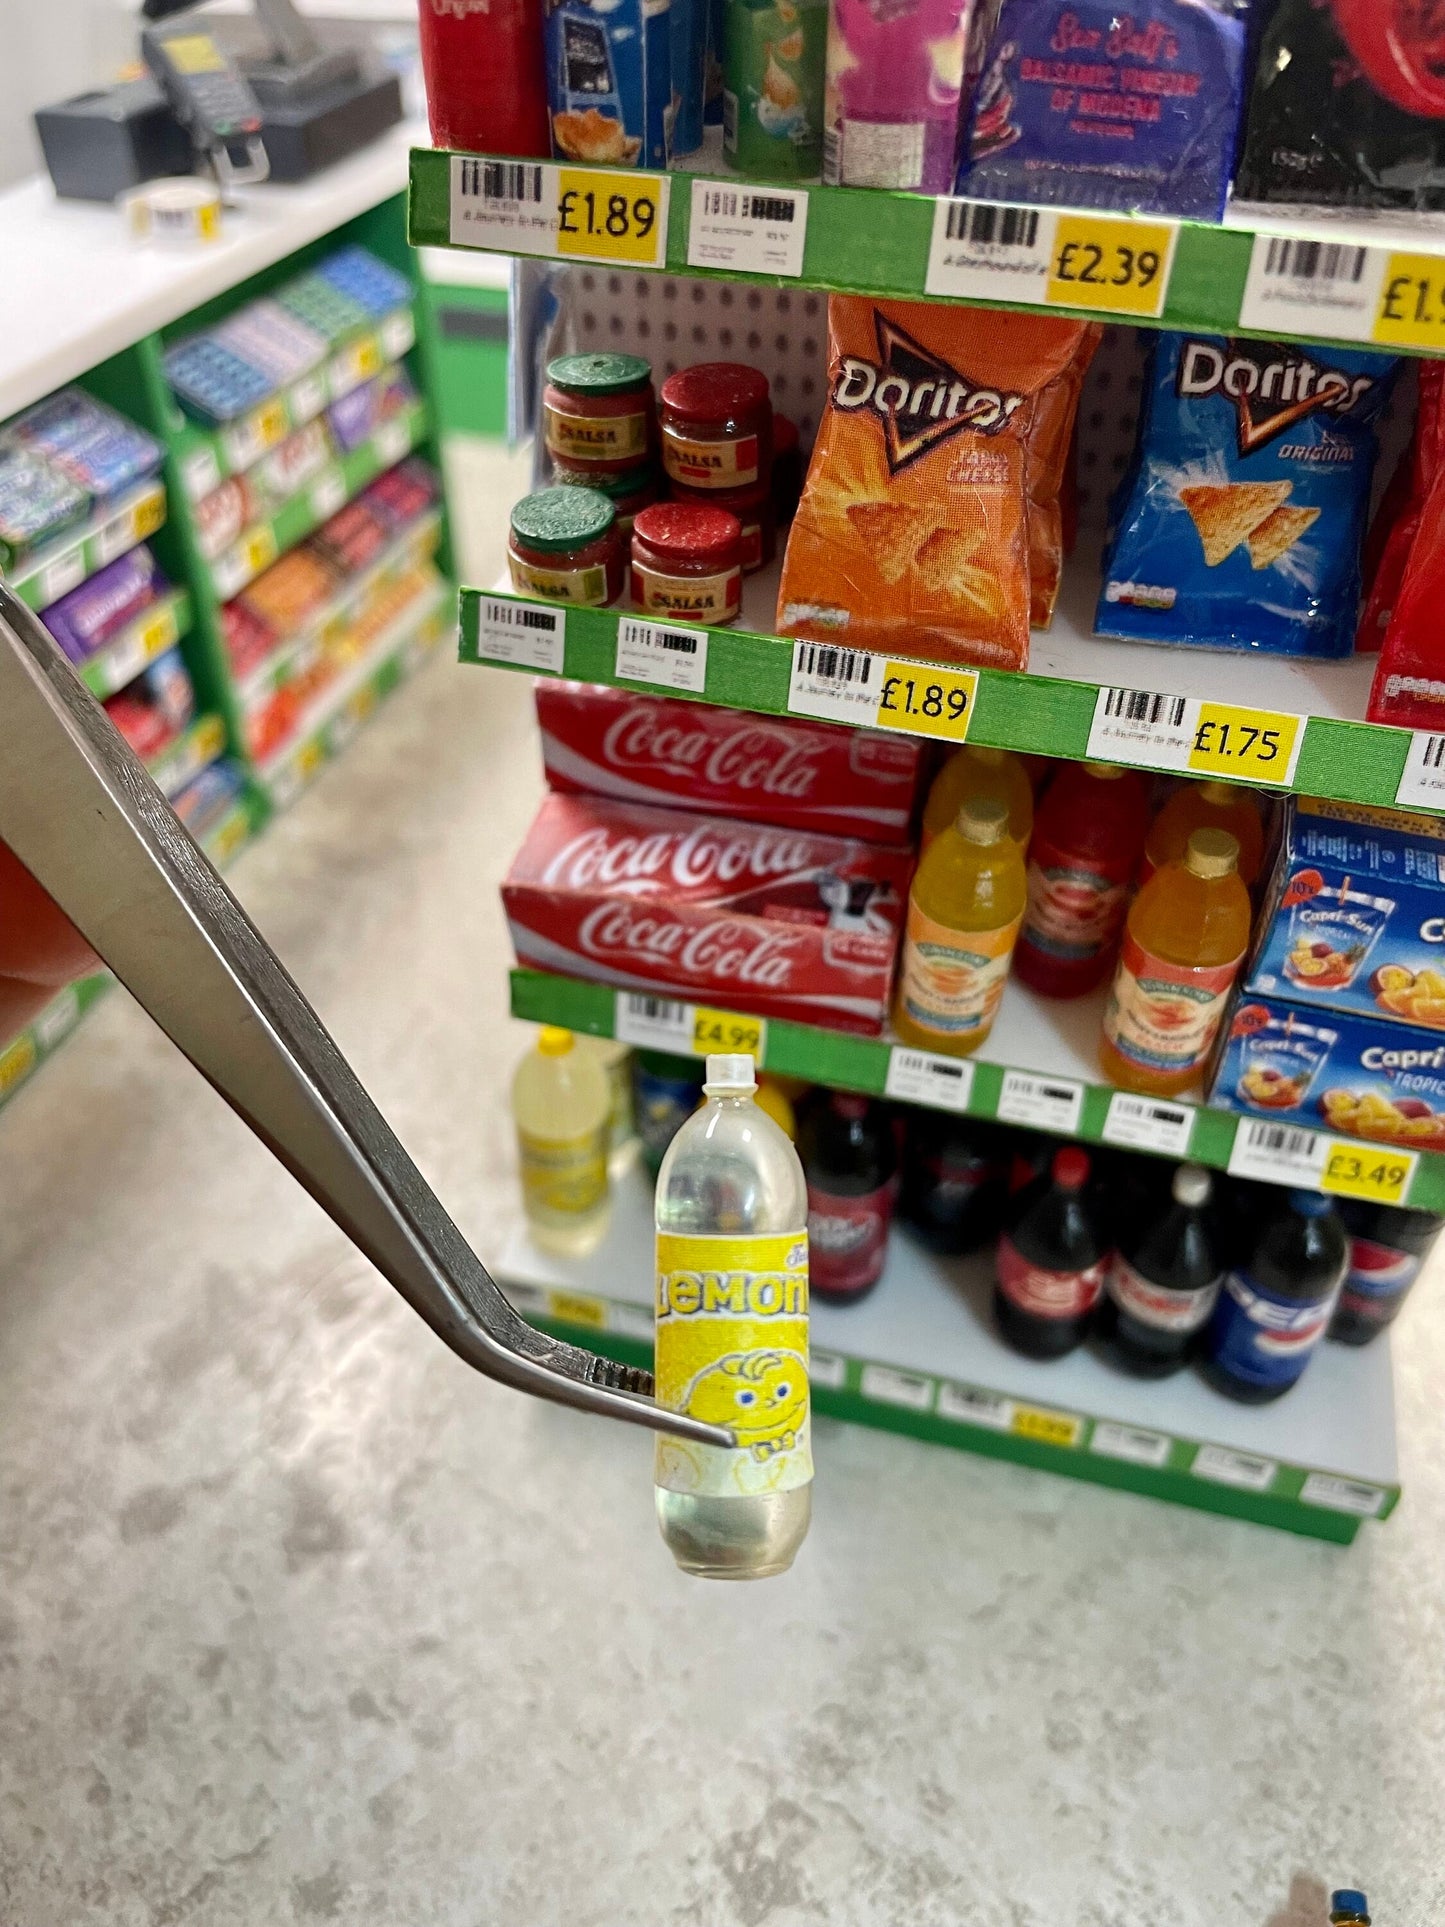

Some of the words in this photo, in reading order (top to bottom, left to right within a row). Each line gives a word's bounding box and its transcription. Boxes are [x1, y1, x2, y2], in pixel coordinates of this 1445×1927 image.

[558, 190, 655, 238] £1.89
[1056, 243, 1161, 288] £2.39
[836, 359, 1023, 427] Doritos
[1181, 343, 1374, 413] Doritos
[880, 677, 968, 721] £1.89
[603, 707, 820, 797] Coca-Cola
[1194, 722, 1280, 761] £1.75
[577, 900, 795, 986] Coca-Cola
[696, 1019, 762, 1050] £4.99
[1326, 1154, 1406, 1188] £3.49
